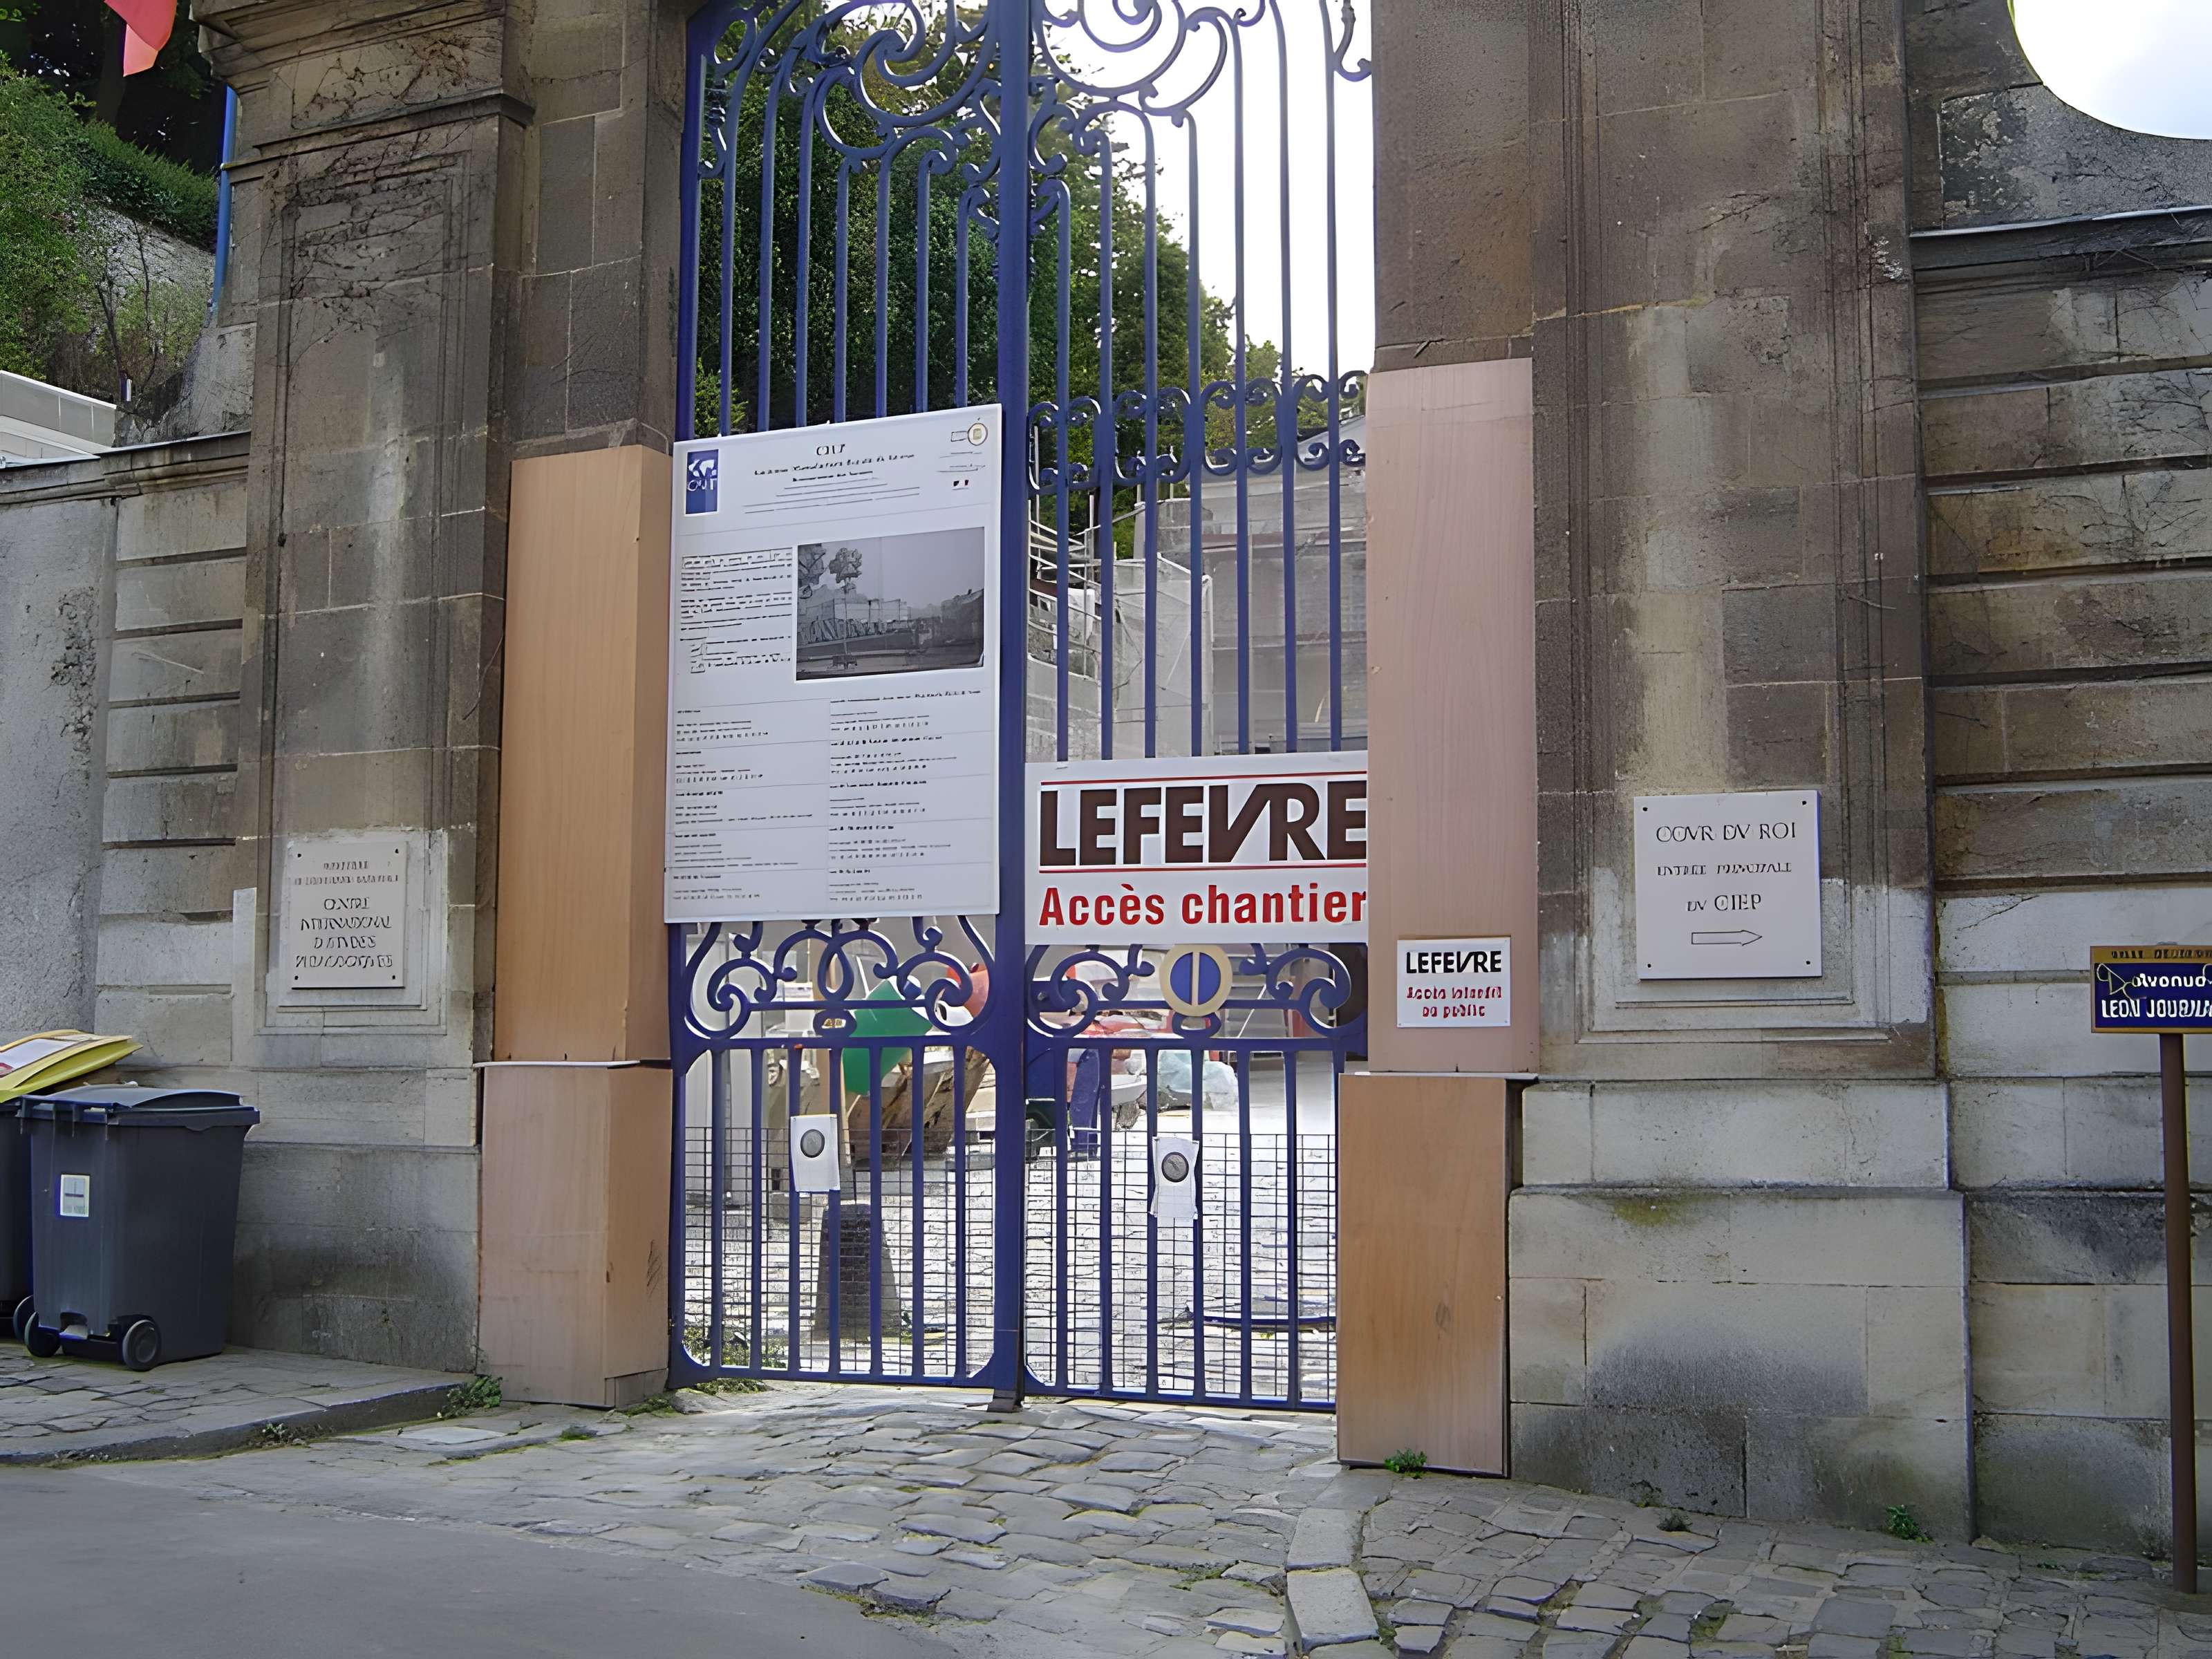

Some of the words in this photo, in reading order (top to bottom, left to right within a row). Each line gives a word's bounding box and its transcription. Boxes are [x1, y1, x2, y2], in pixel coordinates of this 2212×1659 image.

[1040, 780, 1367, 866] LEFEVRE
[1759, 822, 1797, 840] ROI
[1038, 883, 1165, 926] Accès
[1181, 882, 1367, 925] chantier
[1406, 950, 1502, 974] LEFEVRE
